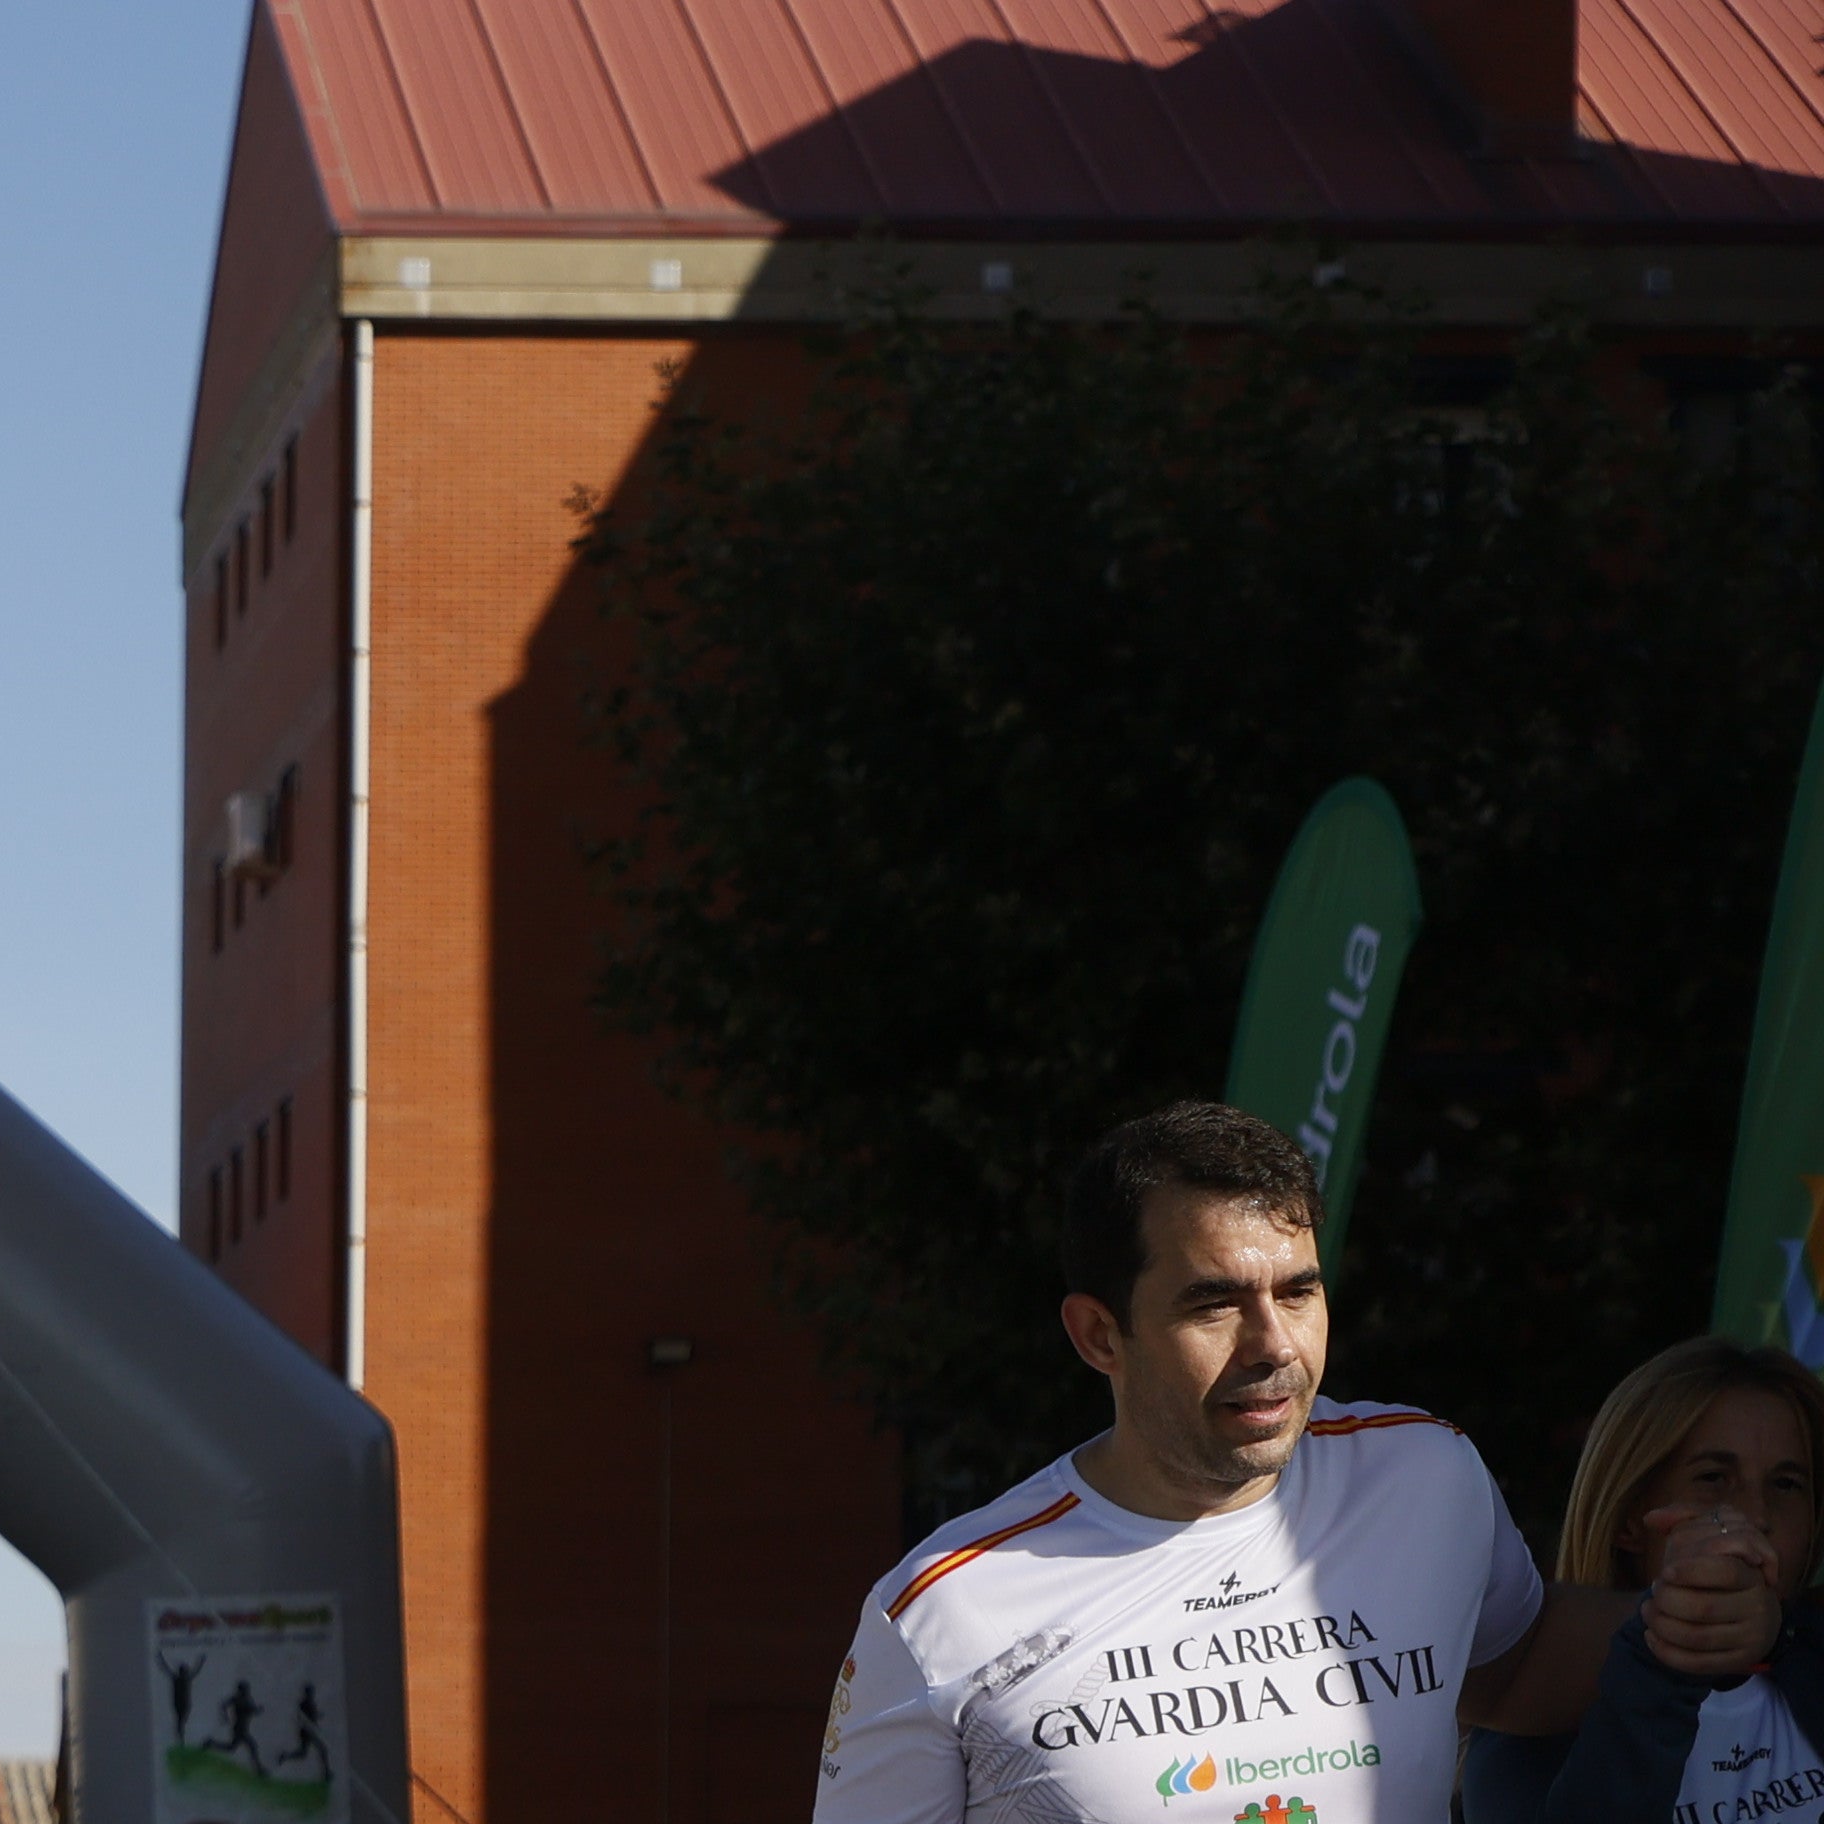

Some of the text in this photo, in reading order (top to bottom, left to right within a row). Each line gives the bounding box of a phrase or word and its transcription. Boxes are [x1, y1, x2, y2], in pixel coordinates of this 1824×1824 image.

[1183, 1583, 1281, 1613] TEAMERGY
[1105, 1609, 1378, 1683] III CARRERA
[1031, 1644, 1444, 1752] GVARDIA CIVIL
[1225, 1739, 1381, 1786] Iberdrola
